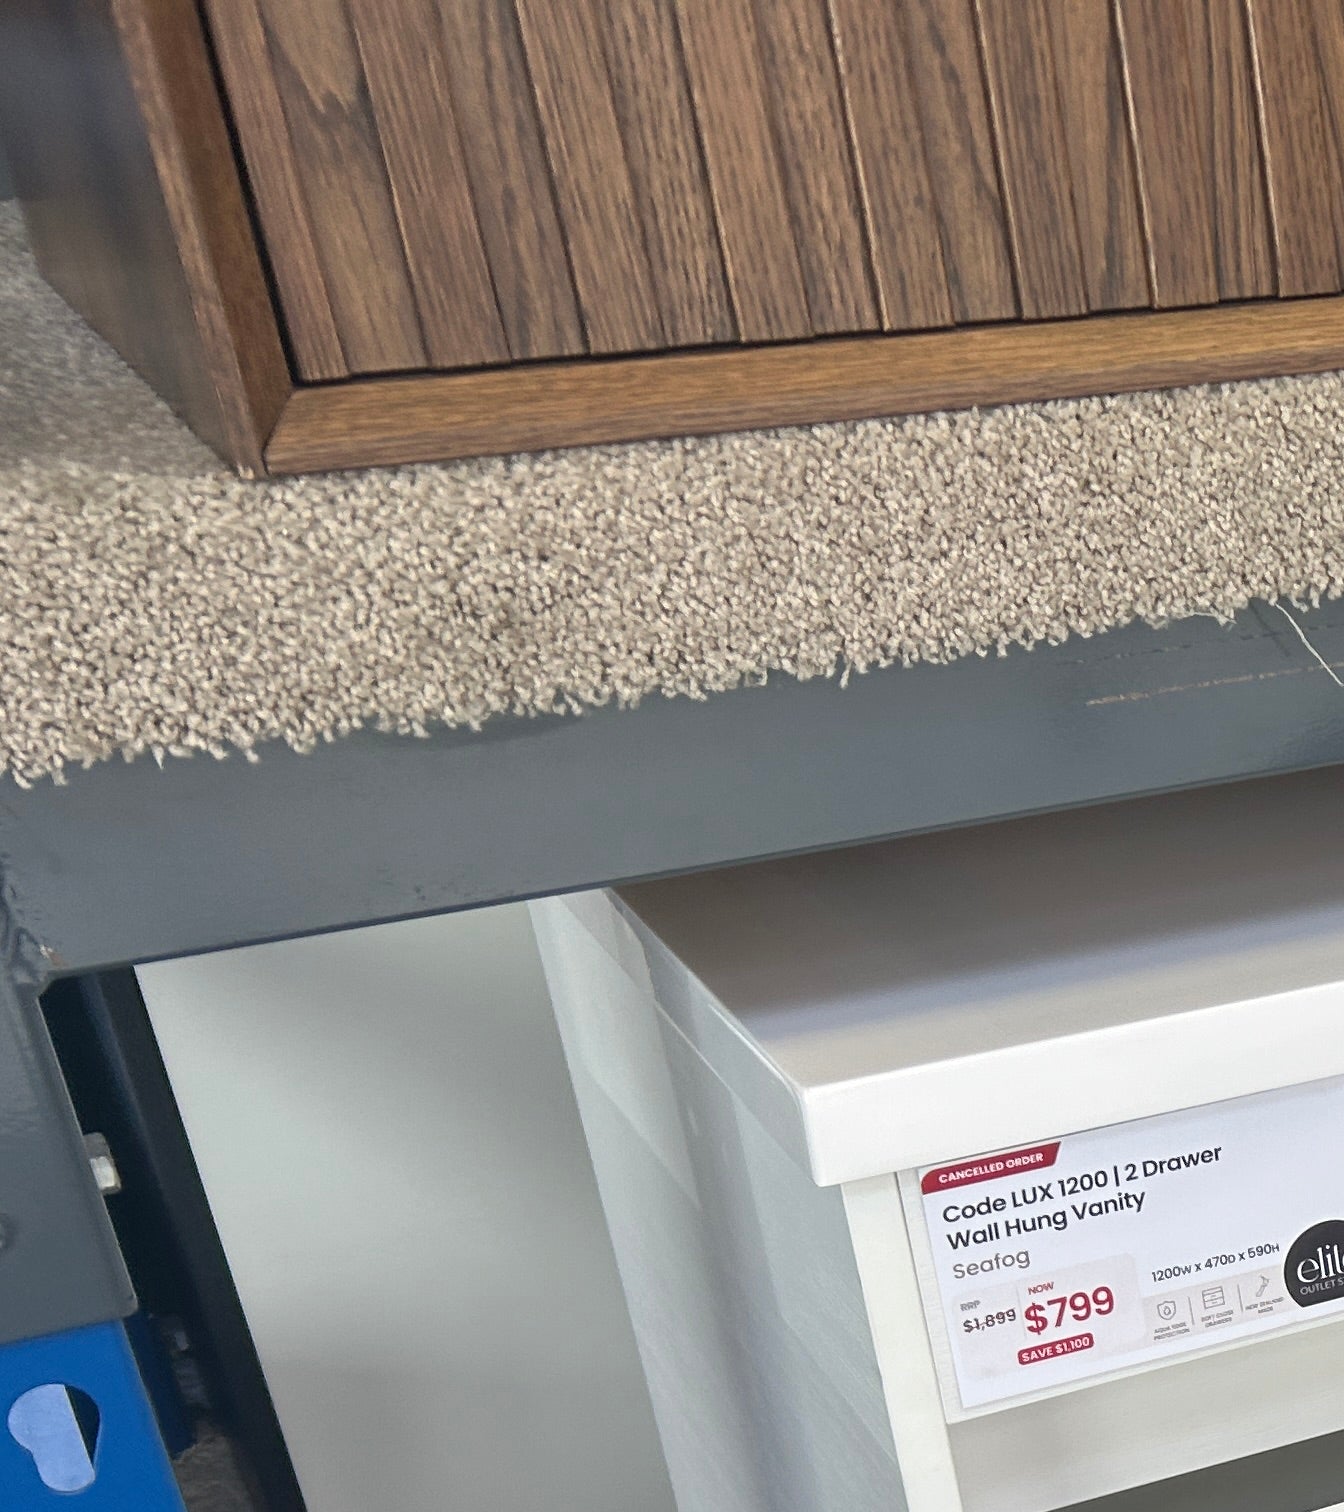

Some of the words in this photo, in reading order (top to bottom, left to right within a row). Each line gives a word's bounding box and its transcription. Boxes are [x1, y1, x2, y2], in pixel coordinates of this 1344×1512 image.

[938, 1161, 1003, 1183] CANCELLED
[1006, 1153, 1044, 1168] ORDER
[943, 1197, 1007, 1223] Code
[1011, 1183, 1054, 1209] LUX
[1058, 1170, 1108, 1196] 1200
[1124, 1164, 1138, 1182] 2
[1142, 1146, 1222, 1177] Drawer
[947, 1222, 1000, 1250] Wall
[1005, 1210, 1068, 1237] Hung
[1071, 1192, 1146, 1221] Vanity
[953, 1250, 1031, 1279] Seafog
[1028, 1282, 1055, 1295] NOW
[1300, 1280, 1336, 1296] OUTLET
[960, 1300, 981, 1312] RRP
[1024, 1286, 1114, 1335] $799
[963, 1308, 1017, 1334] $1,899
[1021, 1347, 1053, 1363] SAVE
